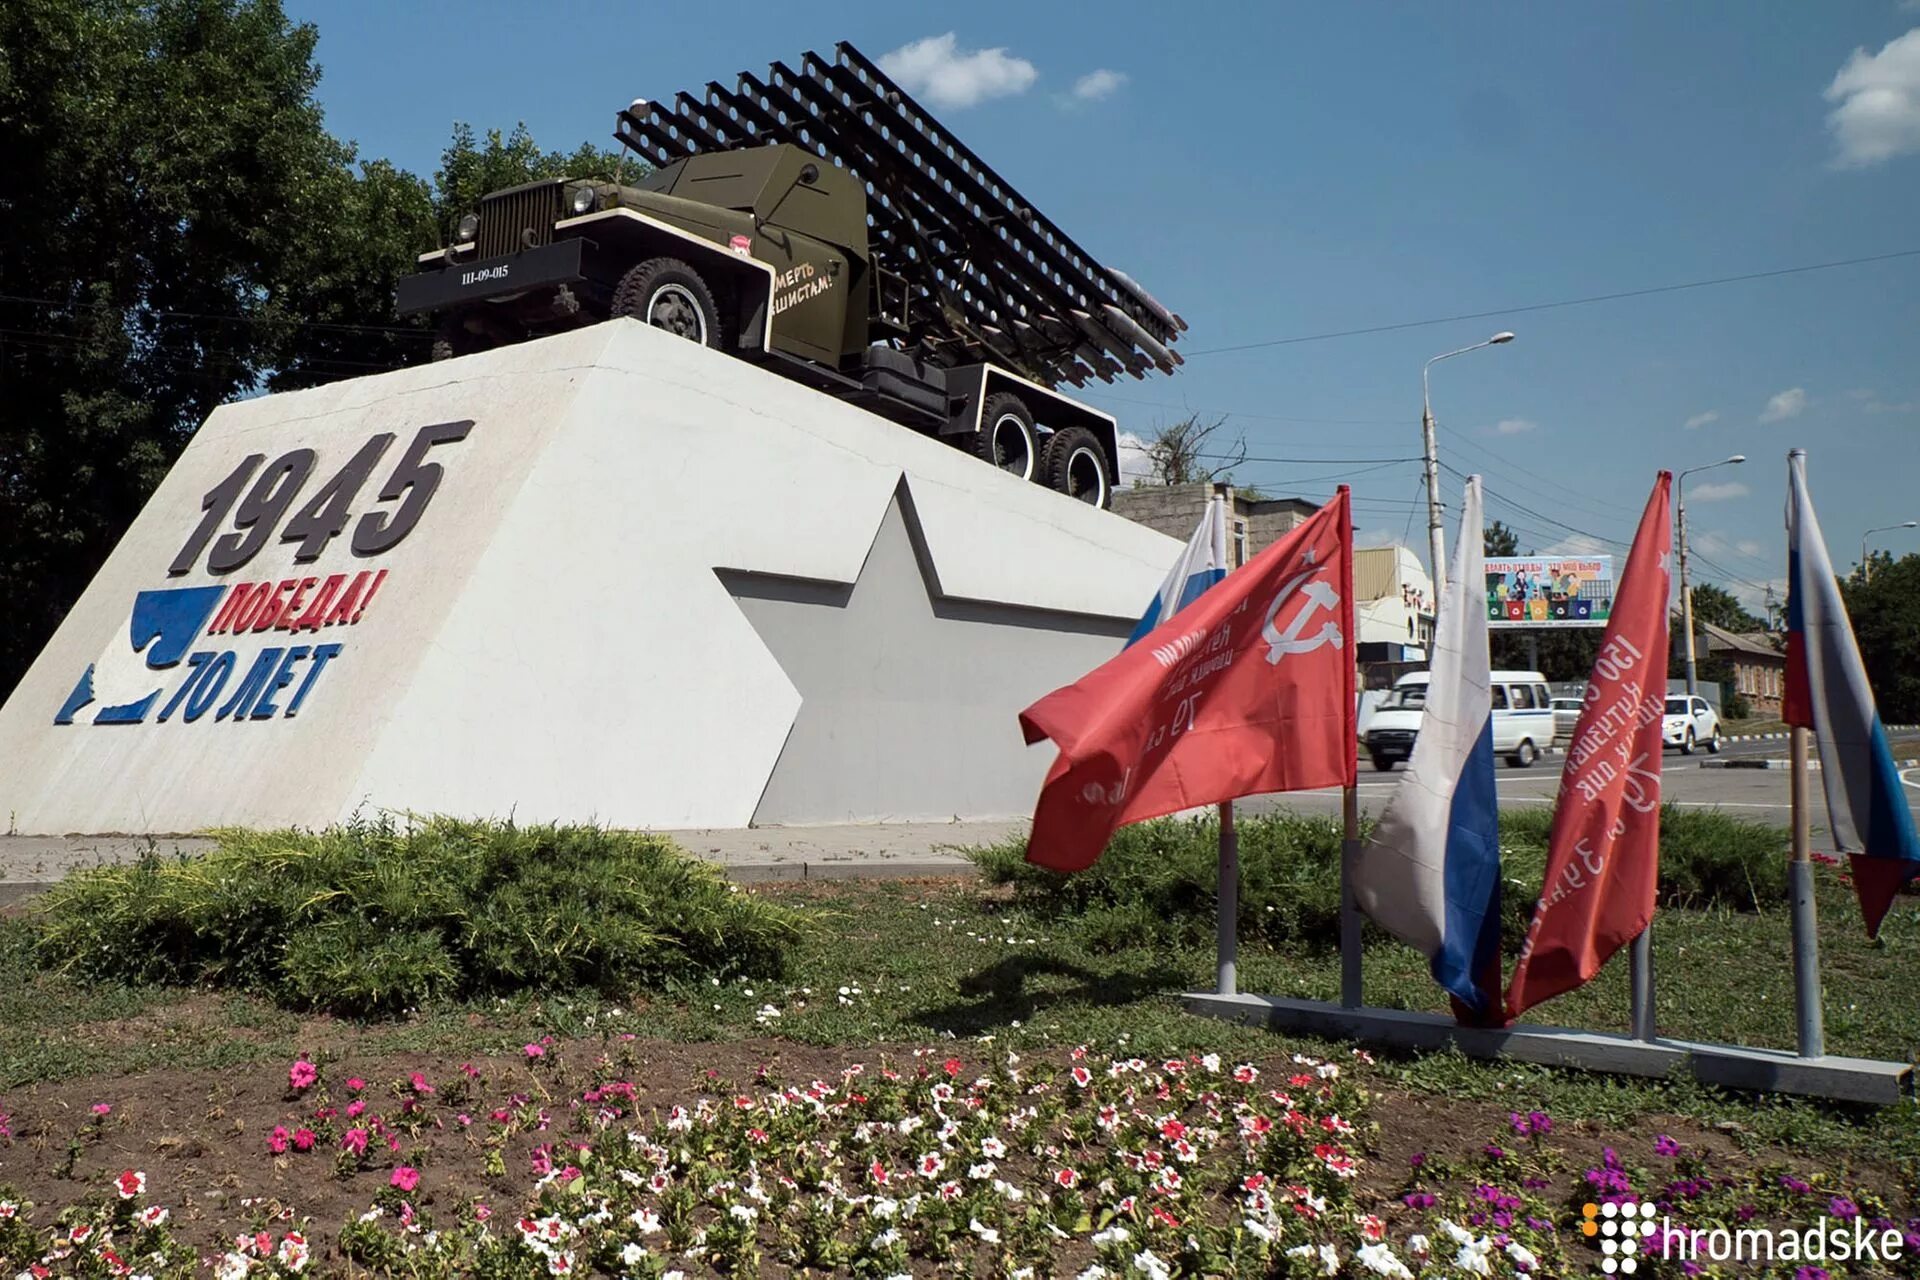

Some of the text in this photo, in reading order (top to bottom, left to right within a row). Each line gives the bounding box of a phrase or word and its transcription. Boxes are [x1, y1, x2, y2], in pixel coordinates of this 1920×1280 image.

[771, 274, 833, 316] ШИСТАМ!
[774, 262, 814, 292] МЕРТЬ
[166, 419, 475, 578] 1945
[207, 569, 389, 636] ПОБЕДА!
[156, 642, 345, 724] 70 ЛЕТ
